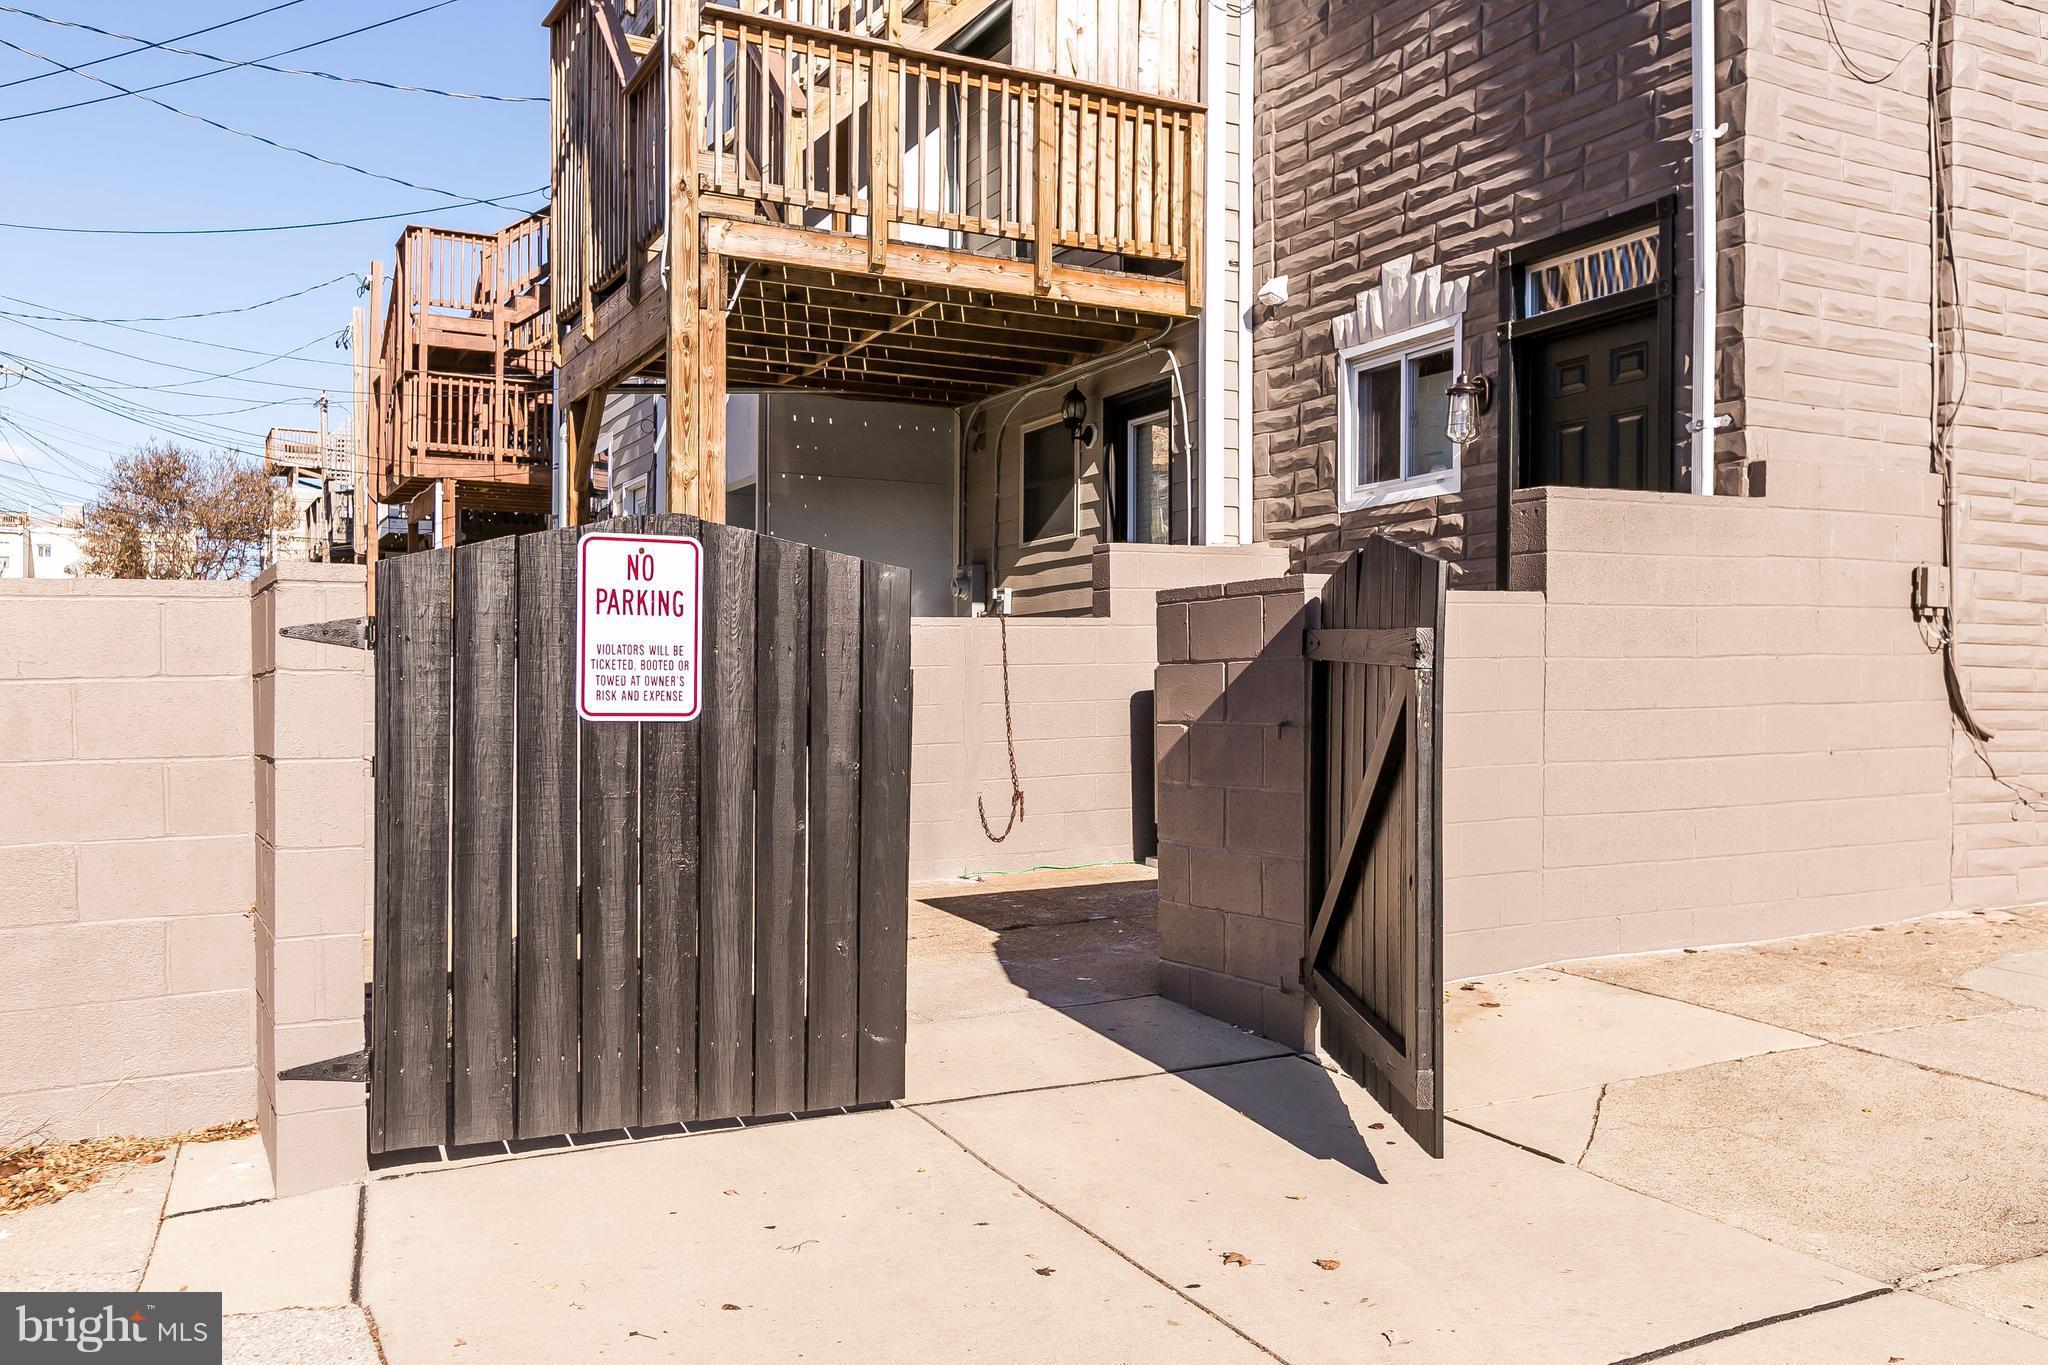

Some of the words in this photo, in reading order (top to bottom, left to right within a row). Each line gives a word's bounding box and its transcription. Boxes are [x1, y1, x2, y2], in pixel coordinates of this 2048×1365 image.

[627, 554, 655, 582] NO
[596, 588, 684, 617] PARKING
[596, 643, 645, 656] VIOLATORS
[648, 644, 669, 656] WILL
[673, 645, 684, 656] BE
[640, 659, 674, 671] BOOTED
[677, 660, 690, 671] OR
[595, 674, 627, 687] TOWED
[630, 675, 641, 687] AT
[644, 675, 685, 687] OWNER'S
[595, 690, 617, 702] RISK
[621, 690, 640, 702] AND
[643, 690, 684, 702] EXPENSE
